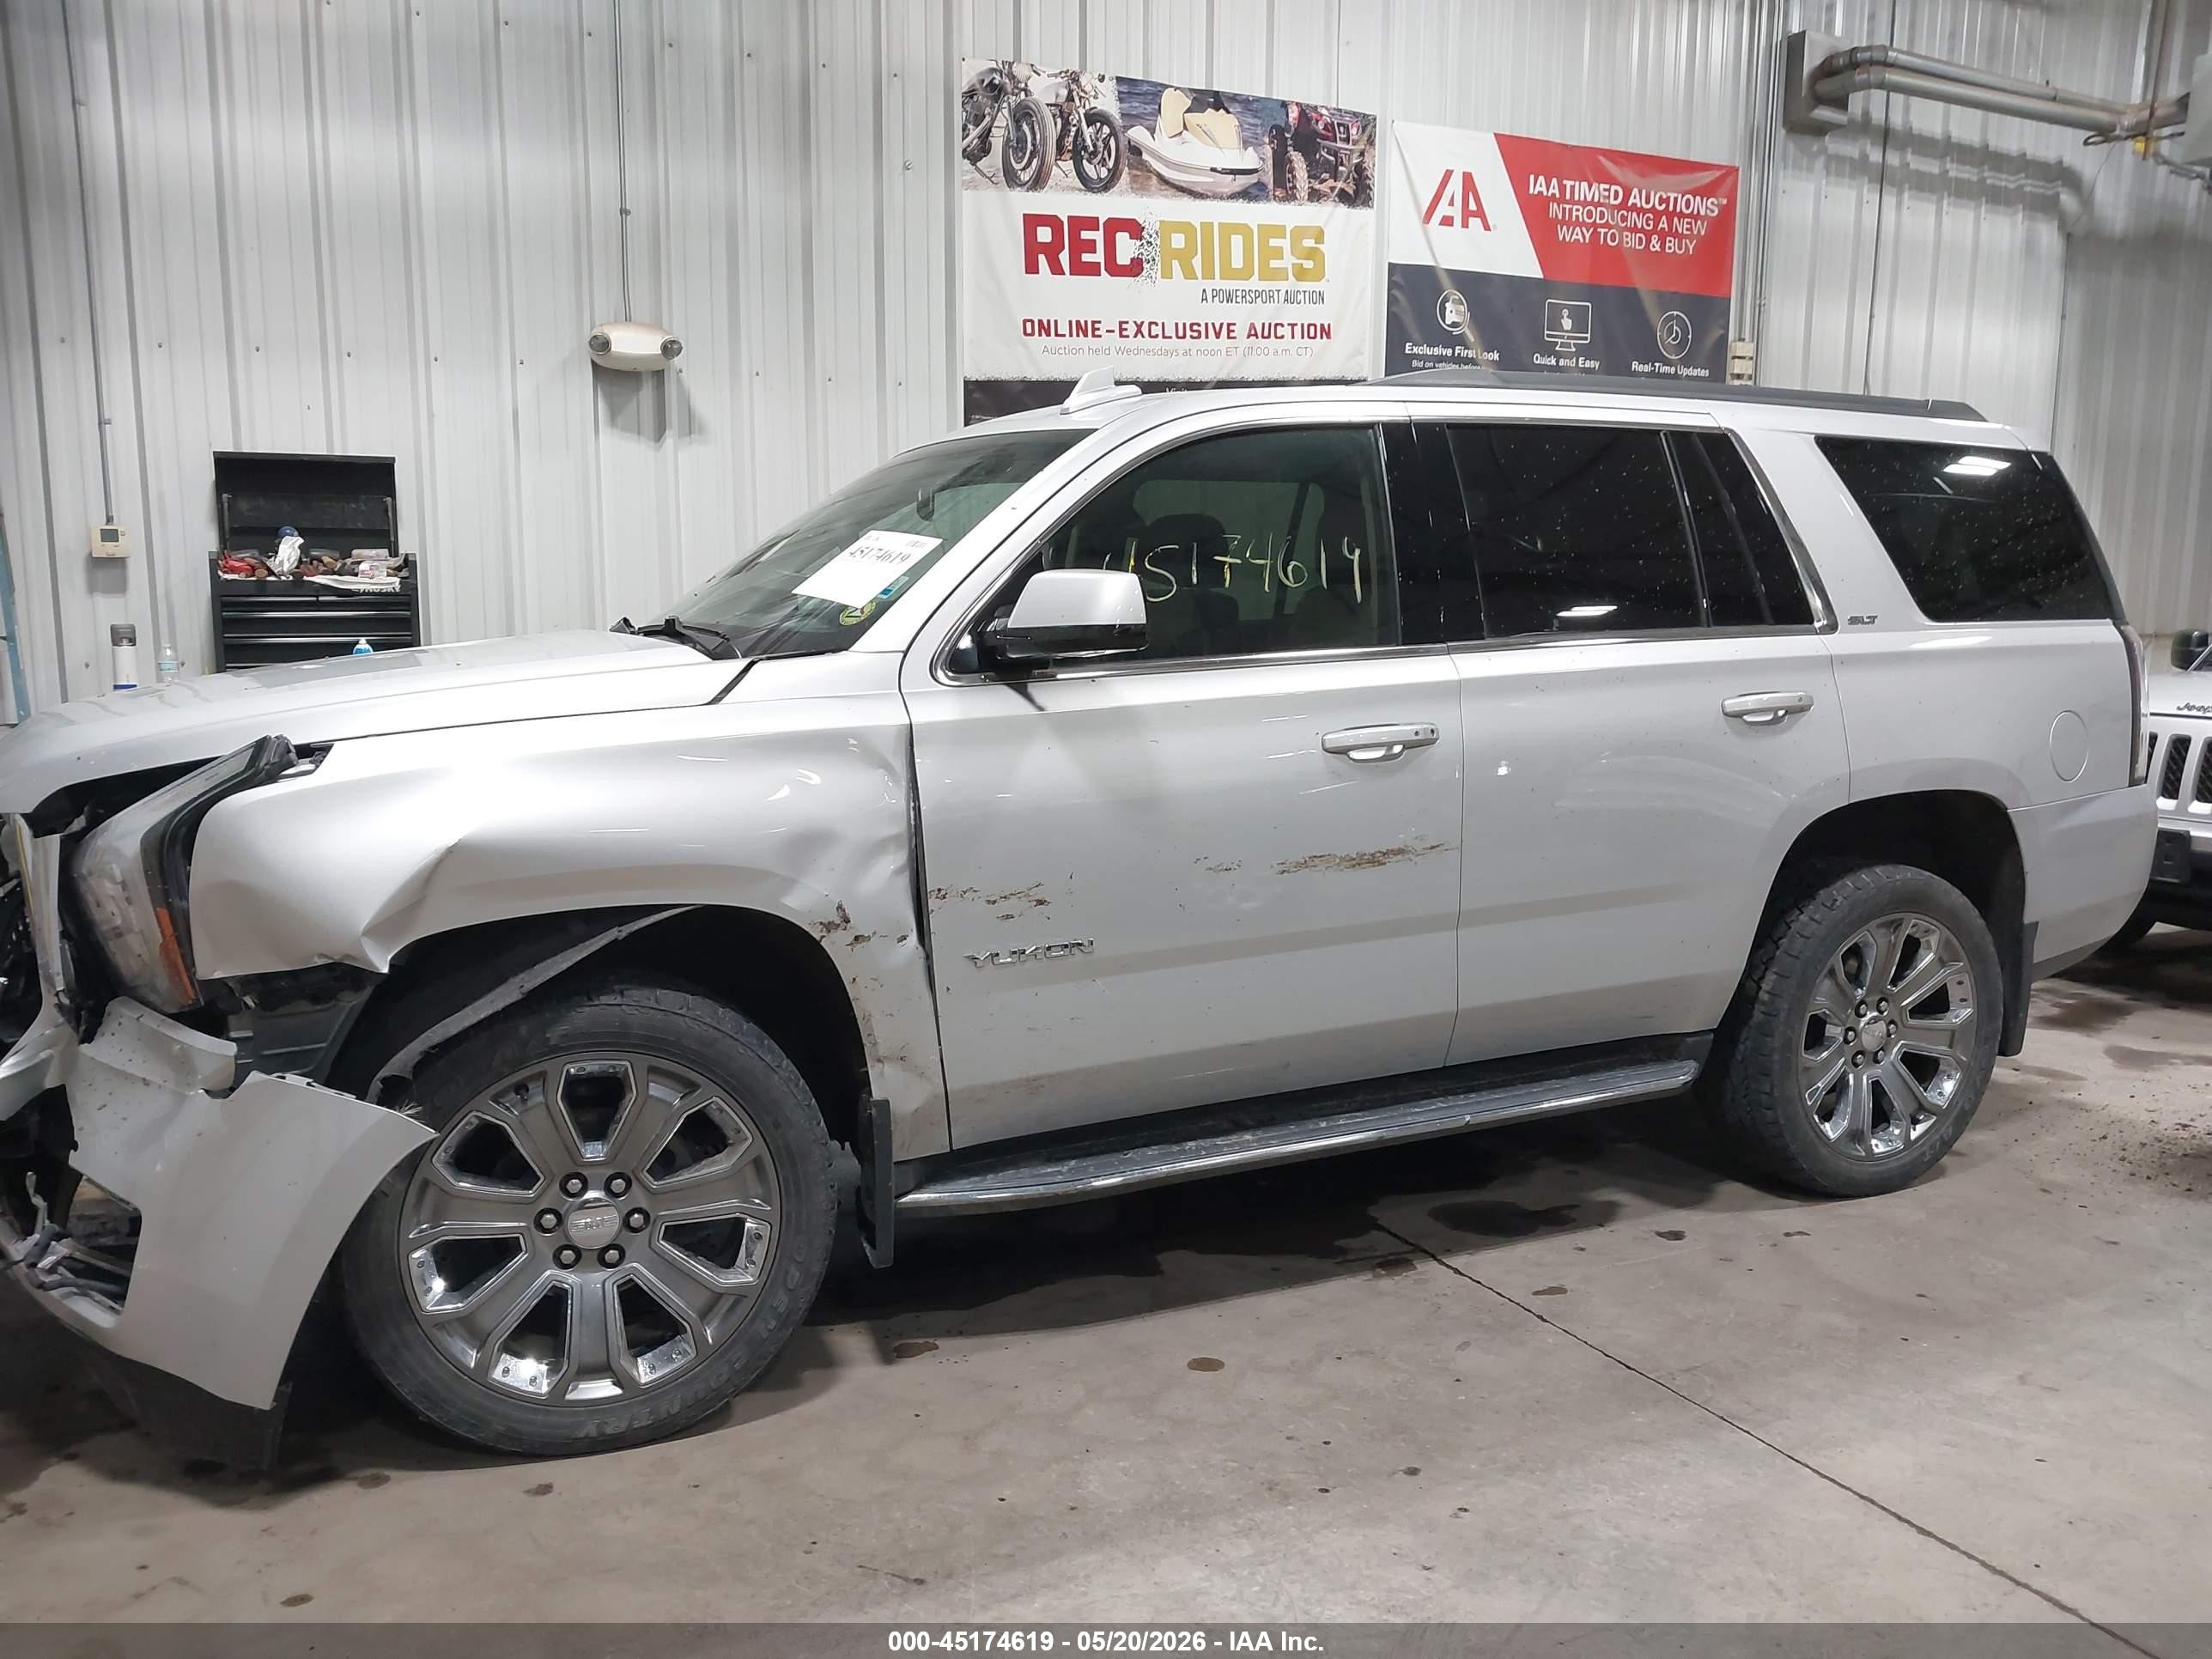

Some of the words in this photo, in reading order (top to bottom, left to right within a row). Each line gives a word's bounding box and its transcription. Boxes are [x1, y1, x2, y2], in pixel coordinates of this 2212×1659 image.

[1529, 173, 1560, 198] IAA
[1562, 179, 1623, 205] TIMED
[1548, 201, 1654, 231] INTRODUCING
[1657, 215, 1668, 232] A
[1672, 216, 1707, 236] NEW
[1022, 213, 1145, 278] REC
[1158, 219, 1326, 283] RIDES
[1557, 224, 1594, 244] WAY
[1597, 228, 1620, 246] TO
[1623, 231, 1646, 250] BID
[1649, 234, 1662, 252] &
[1665, 236, 1697, 255] BUY
[1200, 288, 1208, 304] A
[1212, 289, 1282, 305] POWERSPORT
[1283, 289, 1325, 305] AUCTION
[1022, 319, 1237, 340] ONLINE-EXCLUSIVE
[1246, 322, 1333, 341] AUCTION
[1042, 345, 1085, 356] Auction
[1087, 345, 1111, 356] held
[1115, 345, 1179, 359] Wednesdays
[1182, 348, 1193, 357] at
[1196, 348, 1222, 357] noon
[1225, 347, 1240, 357] ET
[1273, 348, 1294, 357] a.m.
[1405, 342, 1453, 357] Exclusive
[1455, 346, 1476, 359] First
[1412, 359, 1424, 368] Bid
[1534, 353, 1557, 366] Quick
[1559, 356, 1577, 368] and
[1578, 356, 1601, 370] Easy
[1632, 361, 1675, 374] Real-Time
[1677, 365, 1710, 378] Updates
[963, 938, 1095, 969] YUKON
